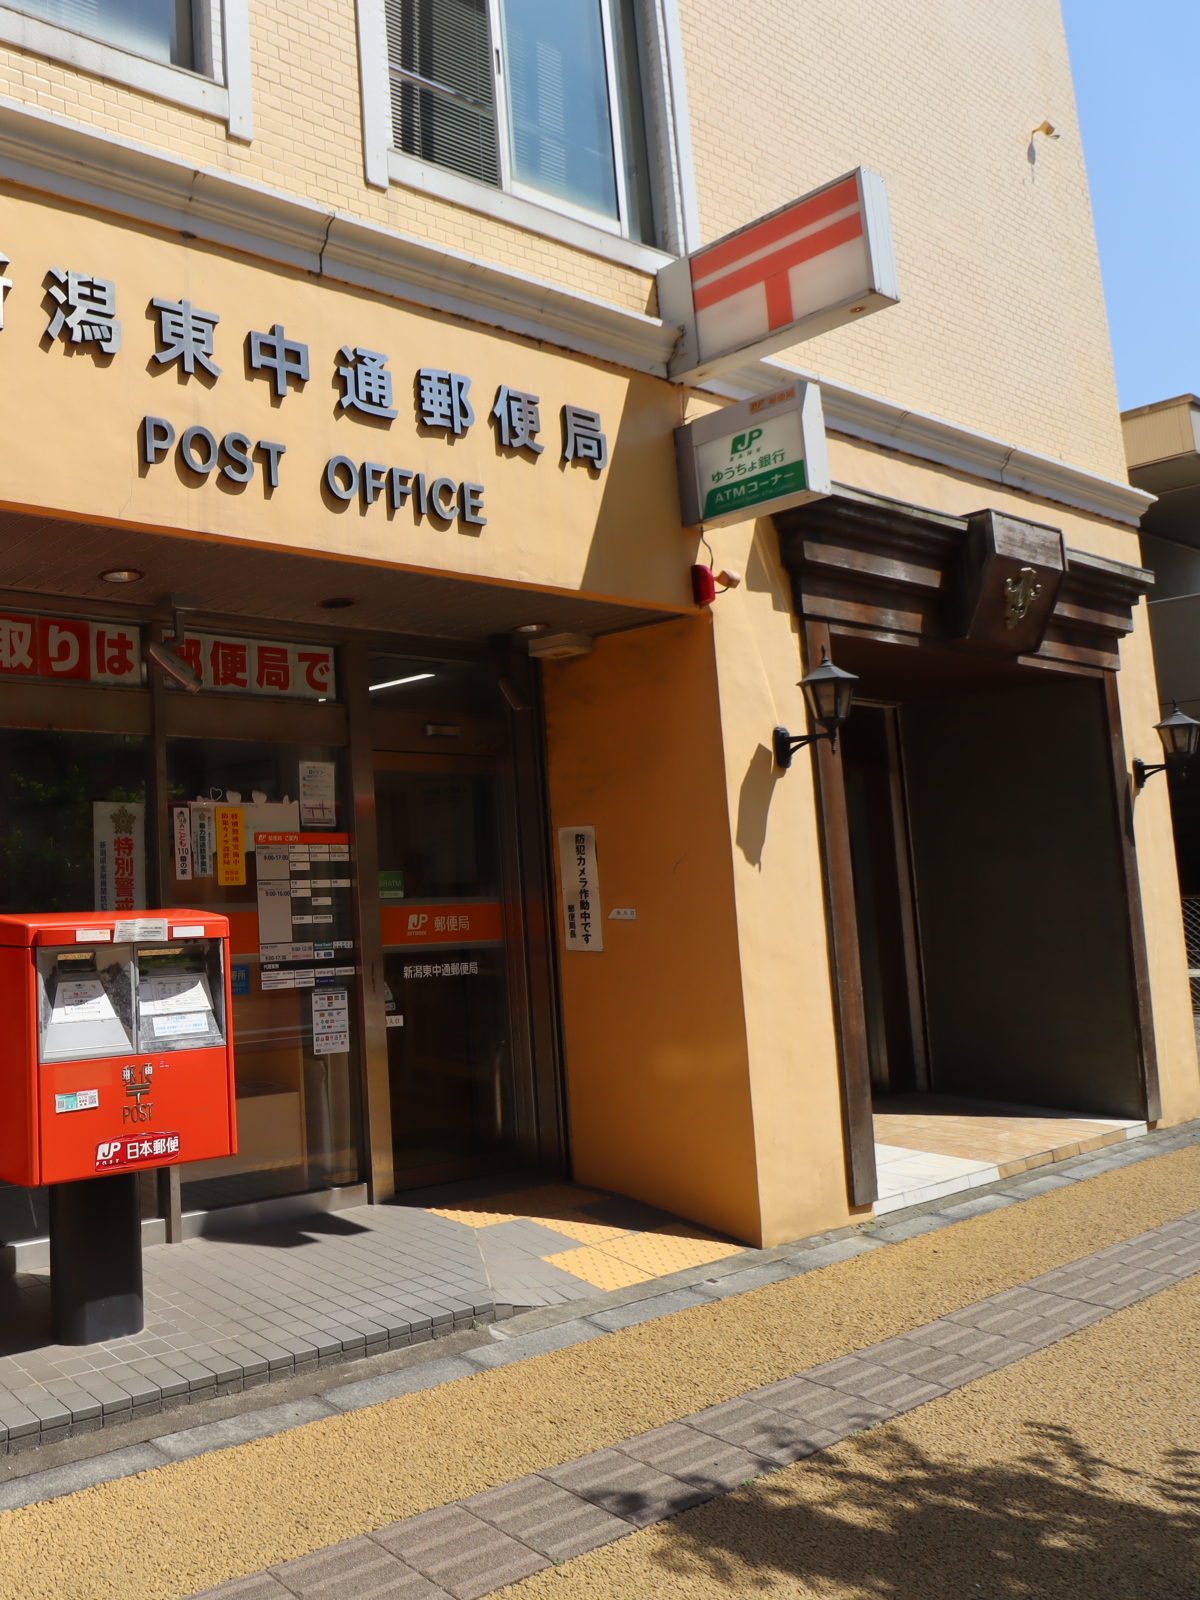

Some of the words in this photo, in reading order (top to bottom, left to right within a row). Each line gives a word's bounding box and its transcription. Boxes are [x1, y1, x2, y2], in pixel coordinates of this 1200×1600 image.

[711, 448, 786, 485] ゆうちょ銀行
[729, 446, 762, 463] BANK
[143, 415, 287, 488] POST
[326, 454, 488, 526] OFFICE
[714, 472, 796, 505] ATMコーナー
[574, 833, 592, 945] 防犯カメラ作動中です
[433, 915, 471, 932] 郵便局
[567, 904, 577, 938] 郵便局長
[402, 961, 479, 980] 新潟東中通郵便局
[122, 1063, 154, 1087] 郵便
[123, 1102, 154, 1124] POST
[127, 1135, 180, 1160] 日本郵便
[95, 1158, 120, 1167] POST
